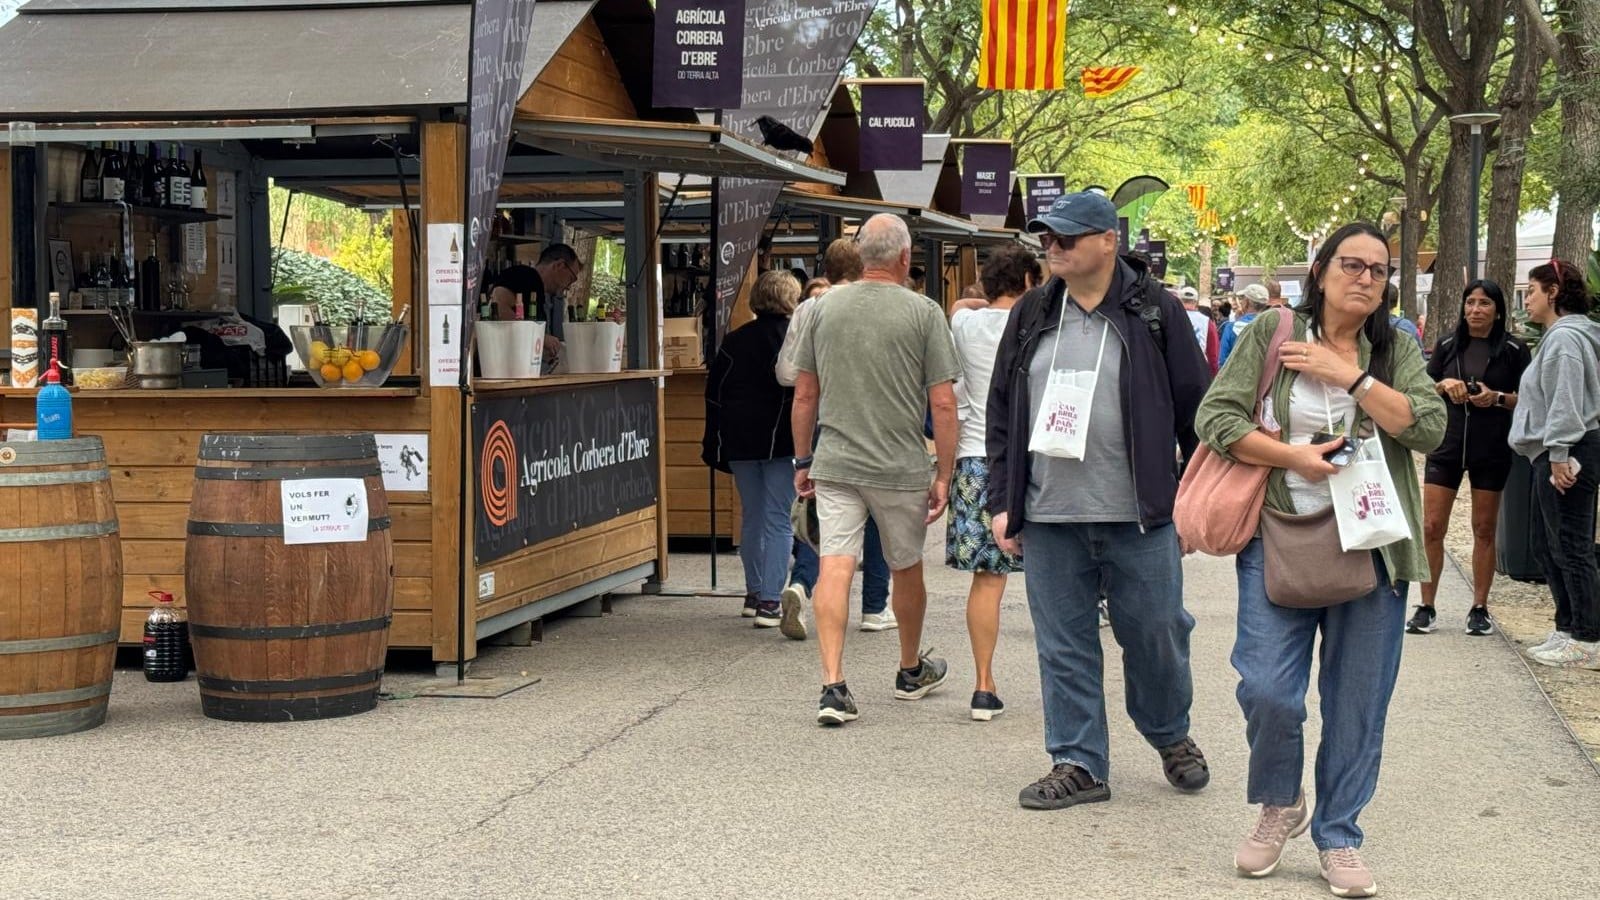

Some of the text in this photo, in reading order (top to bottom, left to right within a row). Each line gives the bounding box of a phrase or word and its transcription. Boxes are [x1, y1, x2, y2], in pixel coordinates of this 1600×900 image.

[676, 7, 726, 25] AGRÍCOLA
[752, 0, 869, 30] Agrícola Corbera d'Ebre
[677, 30, 724, 45] CORBERA
[681, 51, 718, 66] D'EBRE
[686, 71, 705, 79] TERRA
[705, 71, 719, 79] ALTA
[869, 117, 915, 128] CAL PUCOLLA
[520, 429, 650, 496] Agrícola Corbera d'Ebre
[291, 514, 330, 522] VERMUT?
